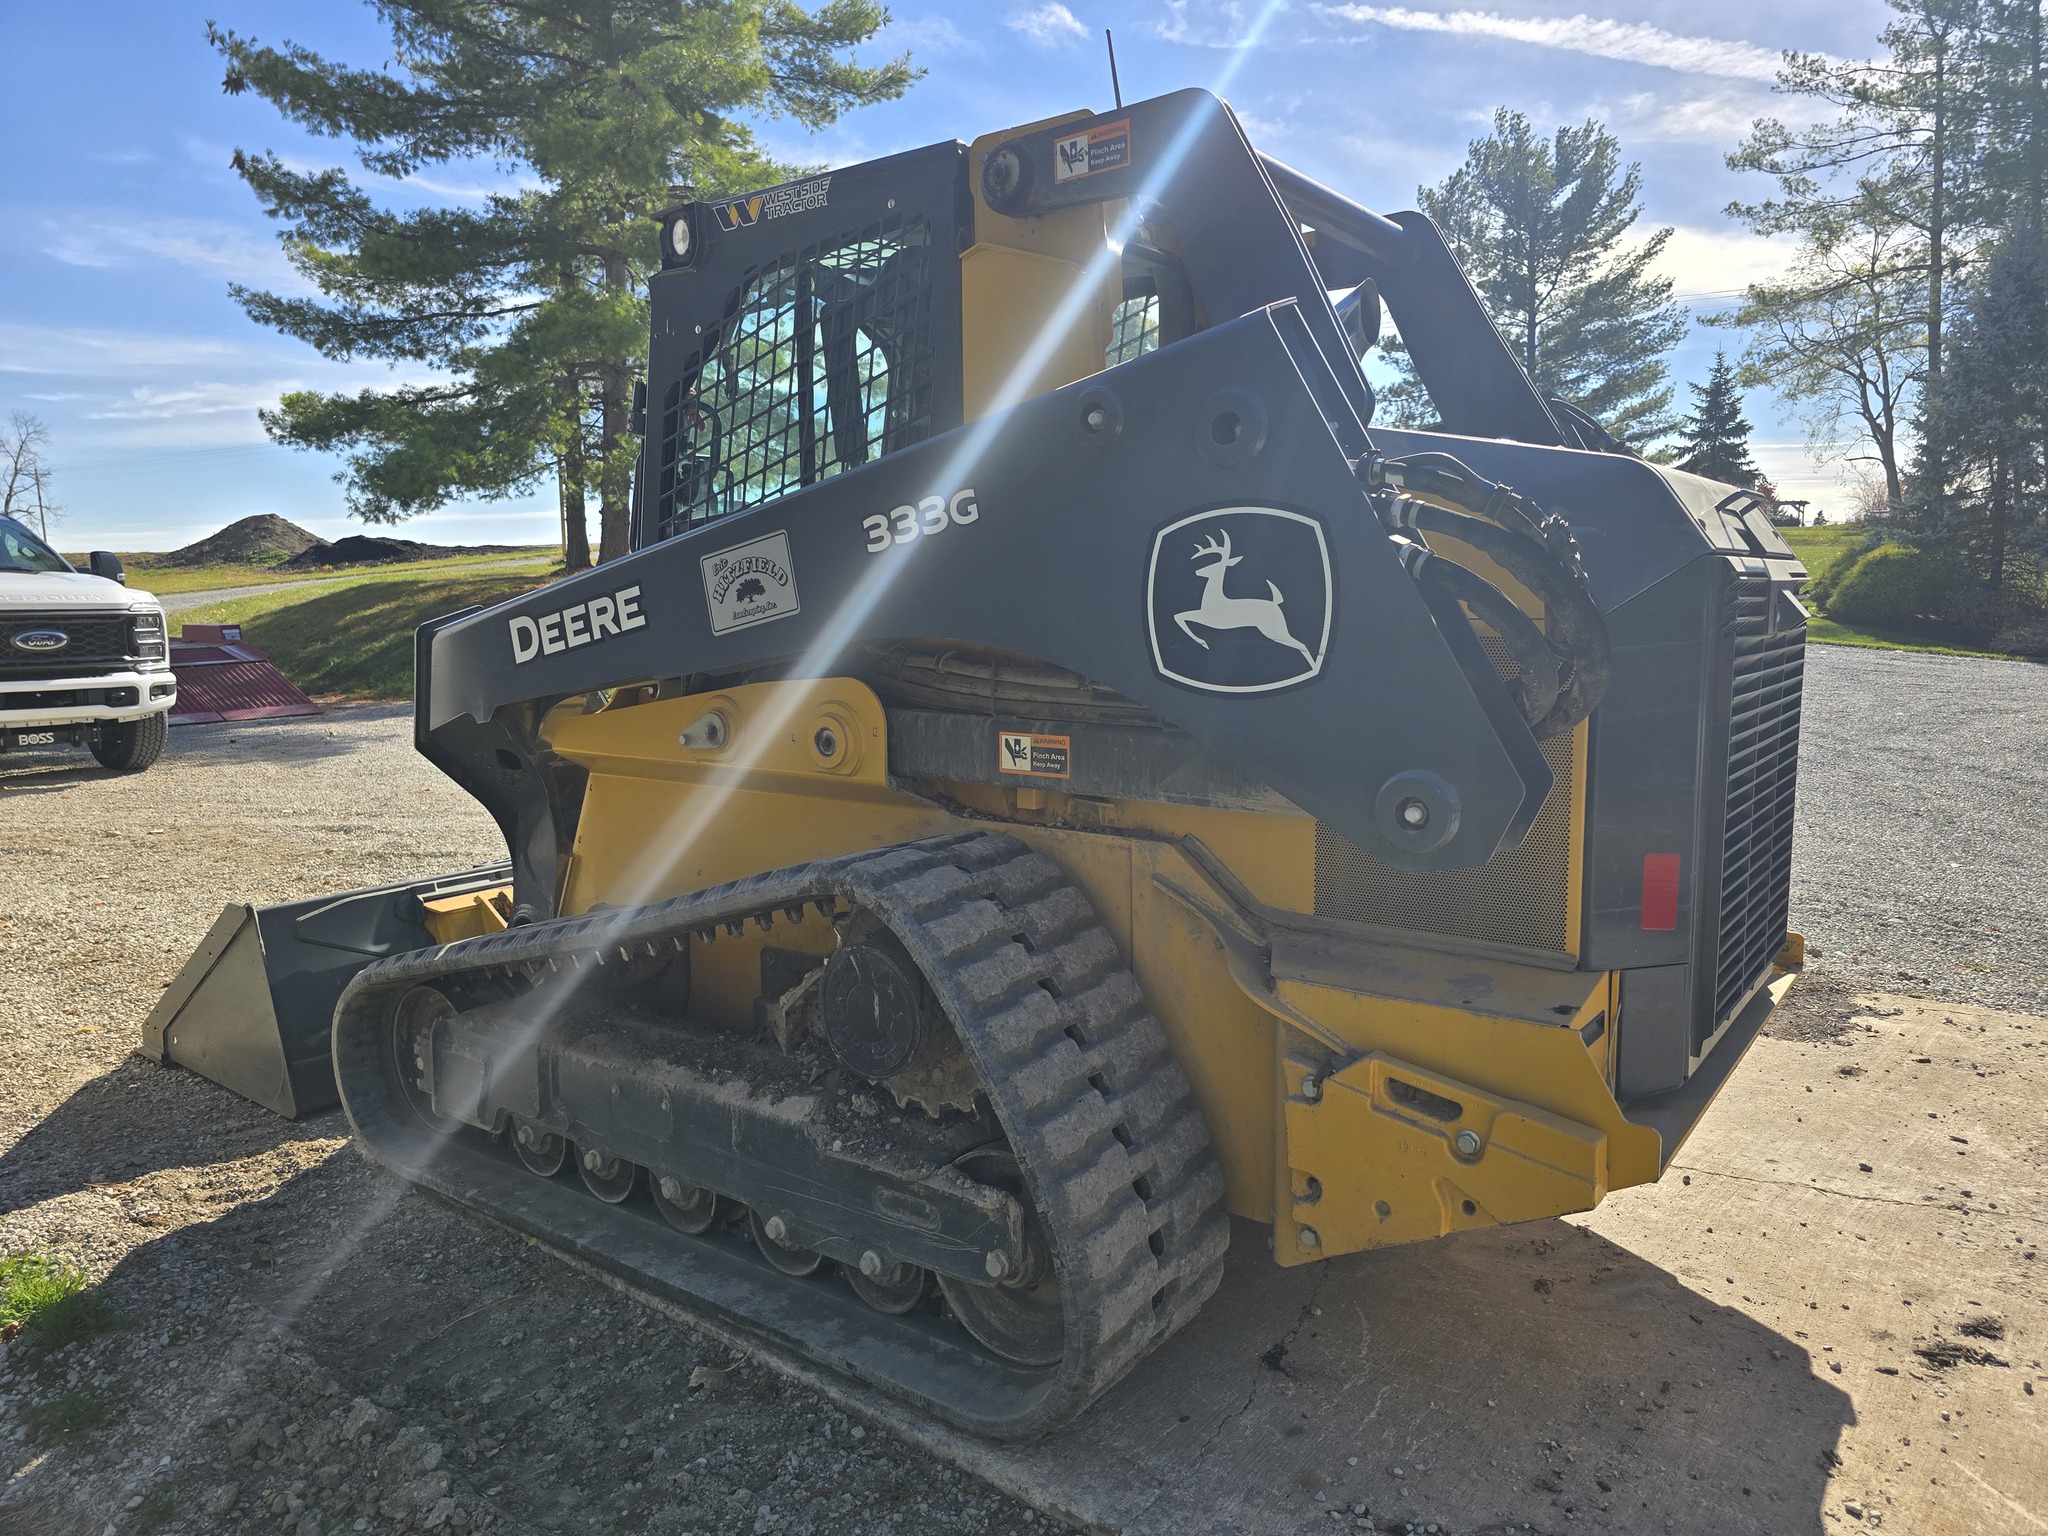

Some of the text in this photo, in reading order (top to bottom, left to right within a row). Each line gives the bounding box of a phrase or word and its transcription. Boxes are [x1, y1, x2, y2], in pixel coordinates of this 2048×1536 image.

[1097, 124, 1126, 138] WARNING
[1091, 143, 1125, 156] Pinch Area
[1091, 153, 1121, 166] Keep Away
[764, 177, 832, 206] WEST SIDE
[765, 192, 828, 220] TRACTOR
[862, 488, 979, 553] 333G
[712, 558, 729, 577] Eric
[713, 556, 788, 604] HITZFIELD
[43, 593, 106, 601] DUTY
[508, 585, 646, 664] DEERE
[28, 635, 56, 646] Ford
[18, 732, 55, 746] BOSS
[1033, 752, 1050, 760] Pinch
[1046, 762, 1061, 770] Away
